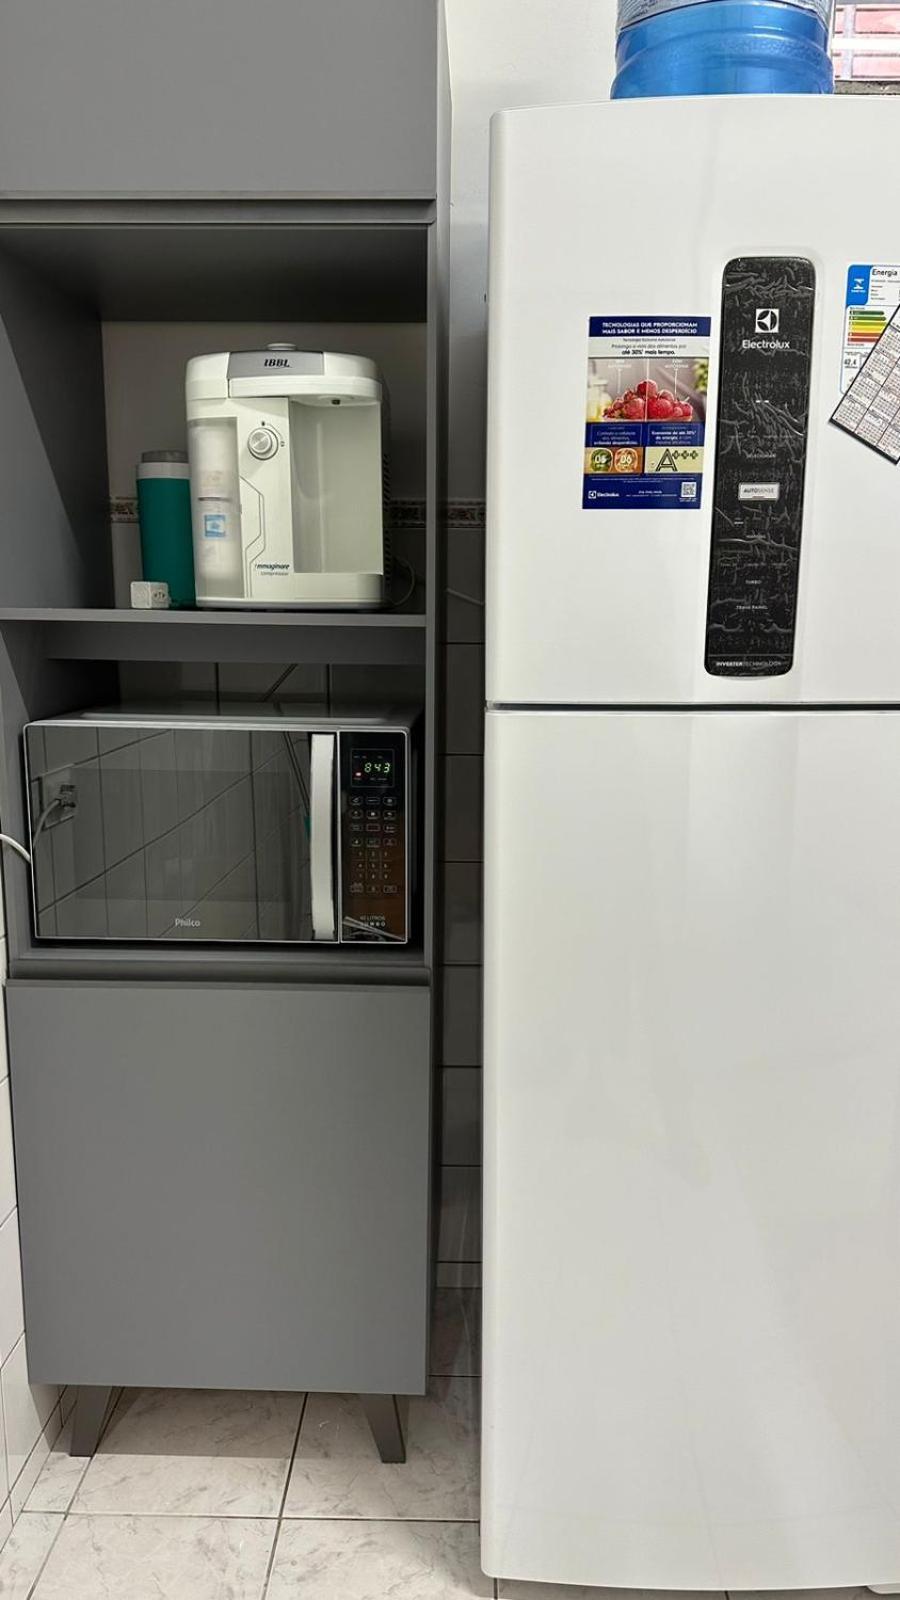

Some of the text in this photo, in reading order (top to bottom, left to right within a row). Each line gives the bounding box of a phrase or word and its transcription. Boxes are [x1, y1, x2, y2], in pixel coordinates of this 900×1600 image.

[872, 268, 898, 277] Energia
[742, 340, 790, 348] Electrolux
[264, 359, 290, 368] IBBL
[176, 918, 200, 927] Philco
